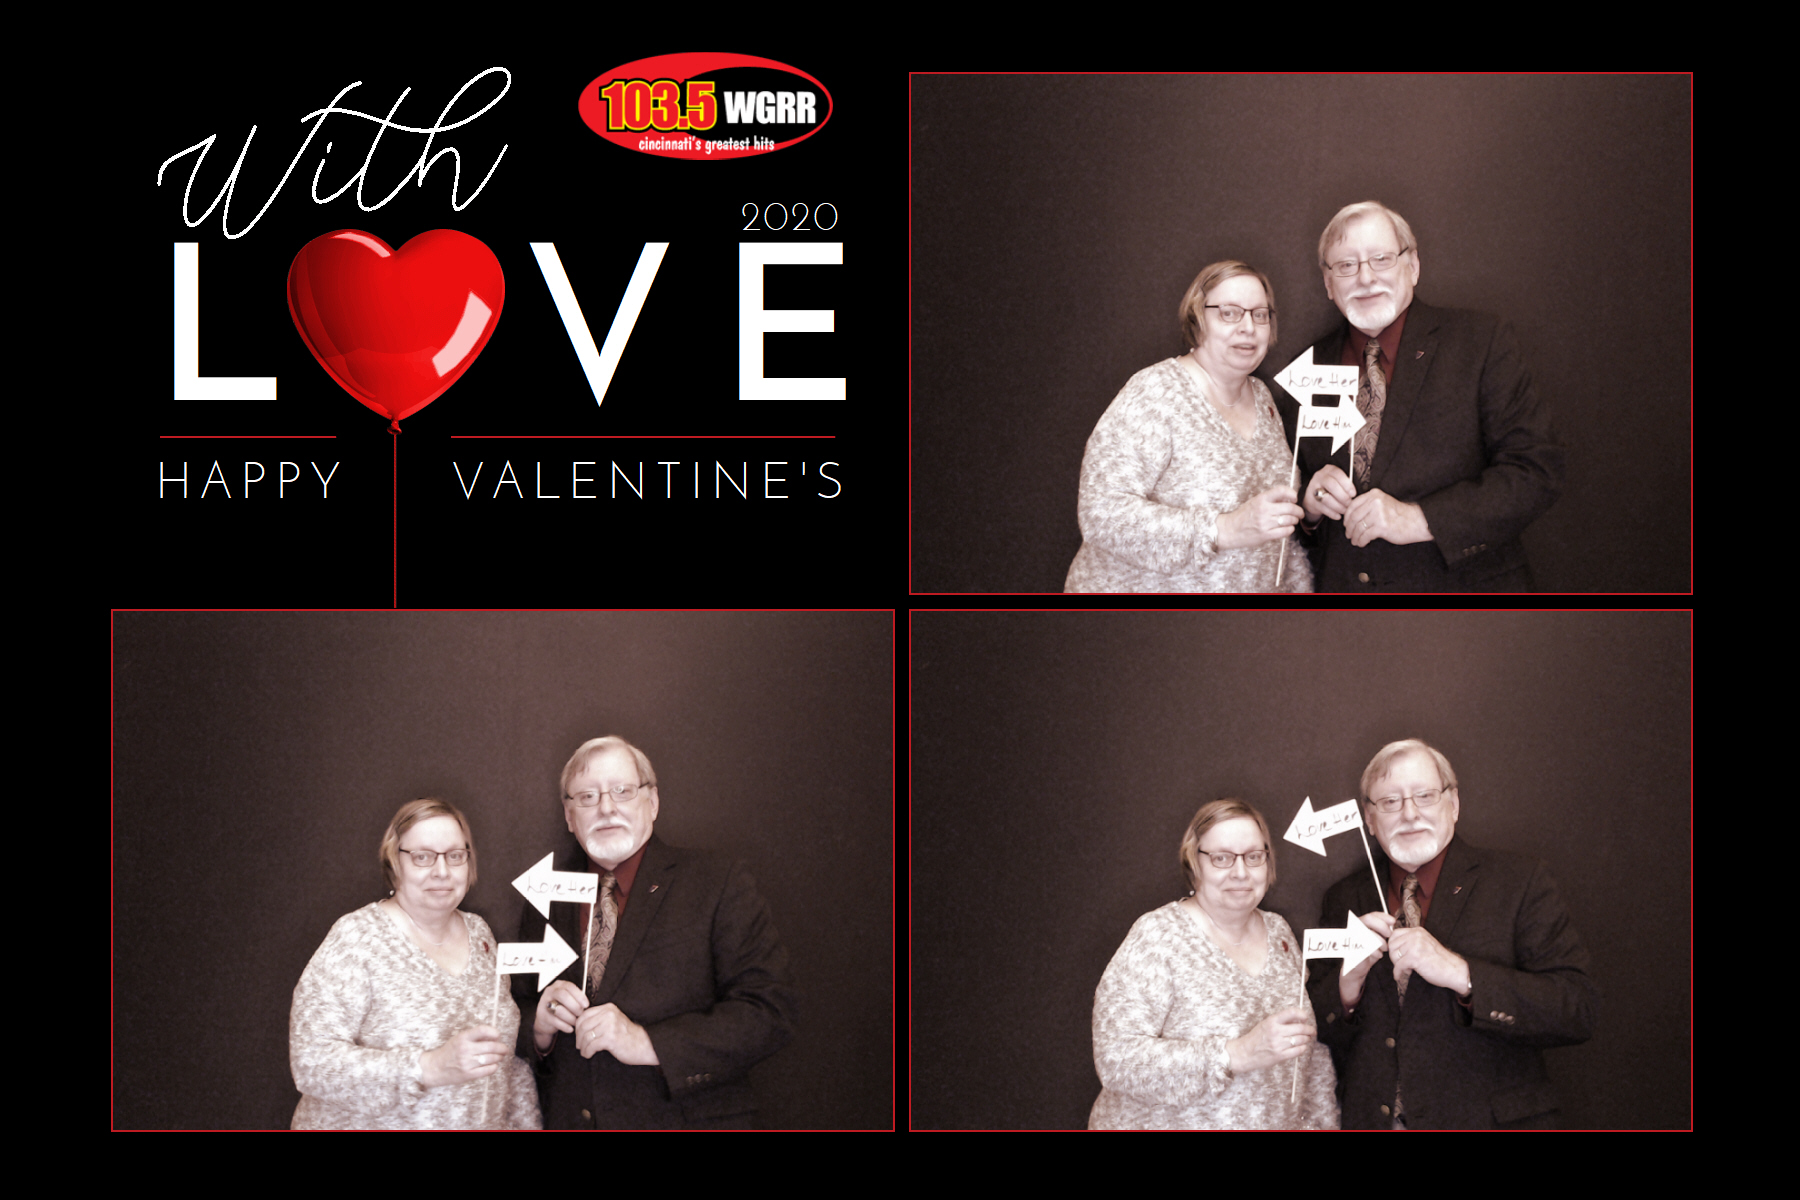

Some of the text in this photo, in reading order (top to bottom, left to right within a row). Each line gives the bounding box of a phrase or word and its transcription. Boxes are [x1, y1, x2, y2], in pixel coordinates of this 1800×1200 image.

[1288, 369, 1358, 389] Love Her
[1301, 414, 1330, 430] Love
[1294, 810, 1358, 840] Love Her
[1307, 936, 1339, 952] Love
